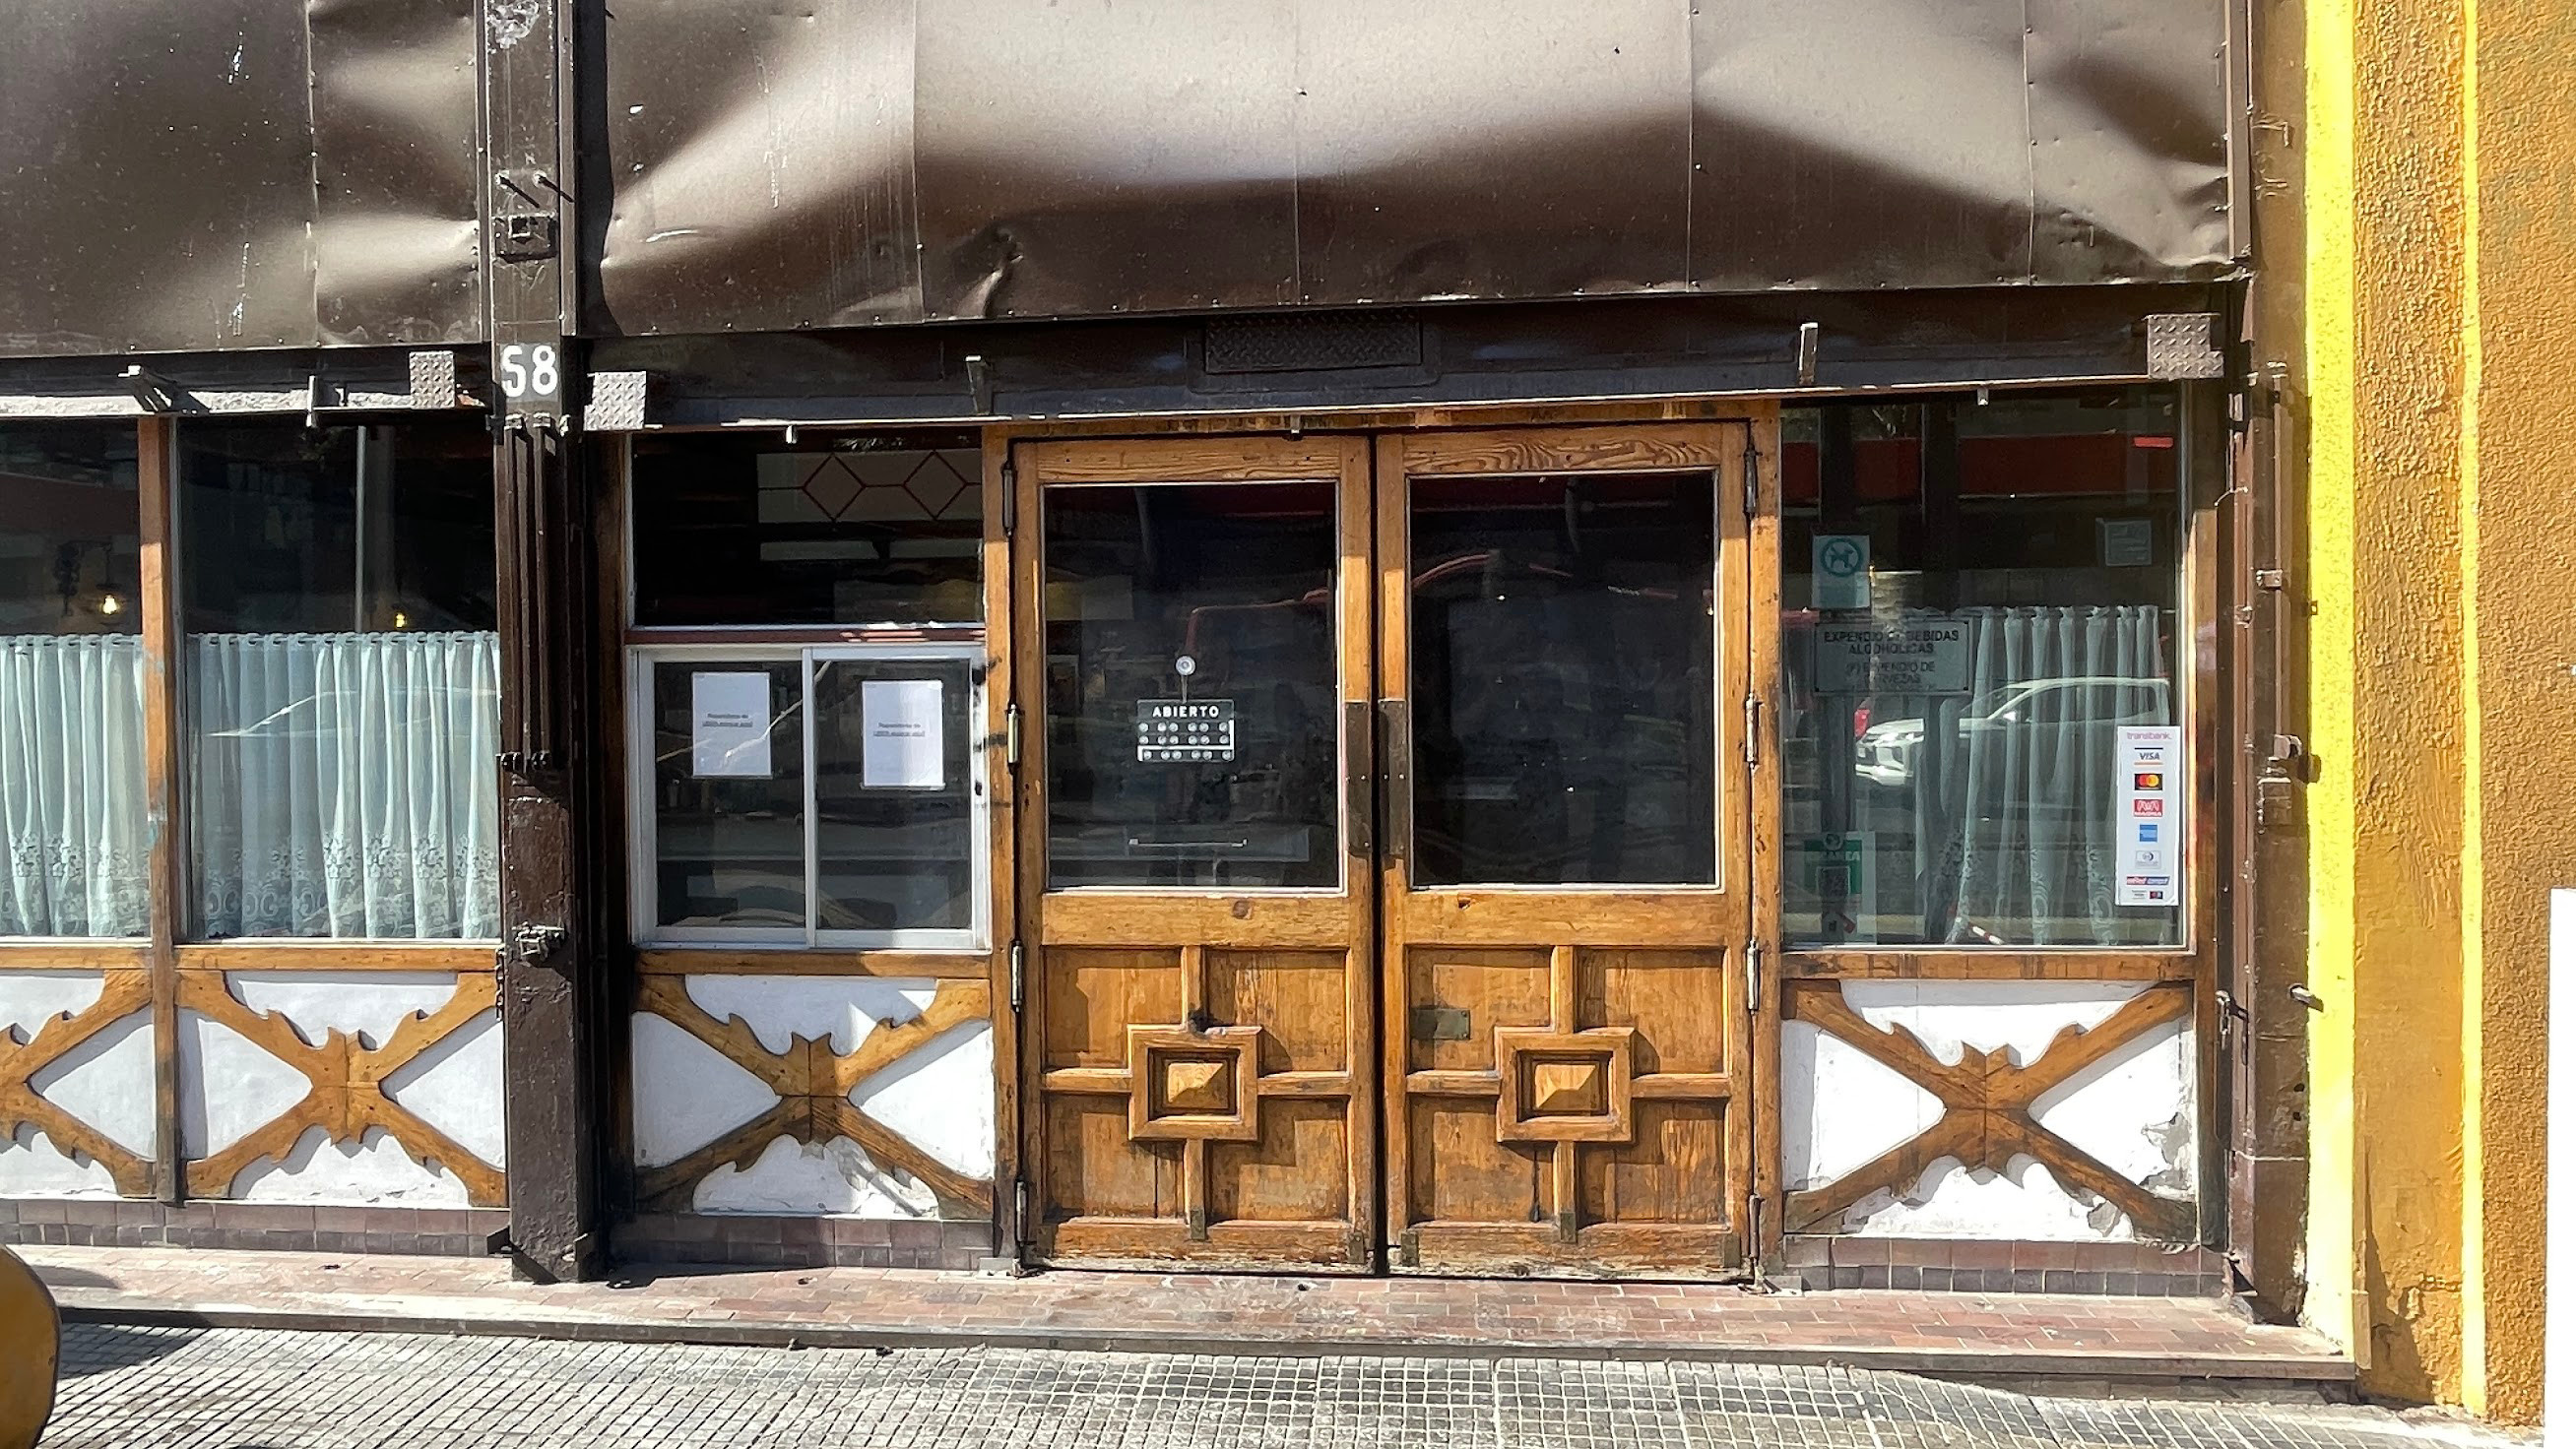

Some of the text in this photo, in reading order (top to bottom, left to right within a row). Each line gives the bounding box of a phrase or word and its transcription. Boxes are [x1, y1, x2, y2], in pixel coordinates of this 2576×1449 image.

[500, 345, 558, 398] 58
[1824, 630, 1884, 643] EXPENDIO
[1905, 630, 1960, 642] BEBIDAS
[1152, 705, 1220, 719] ABIERTO
